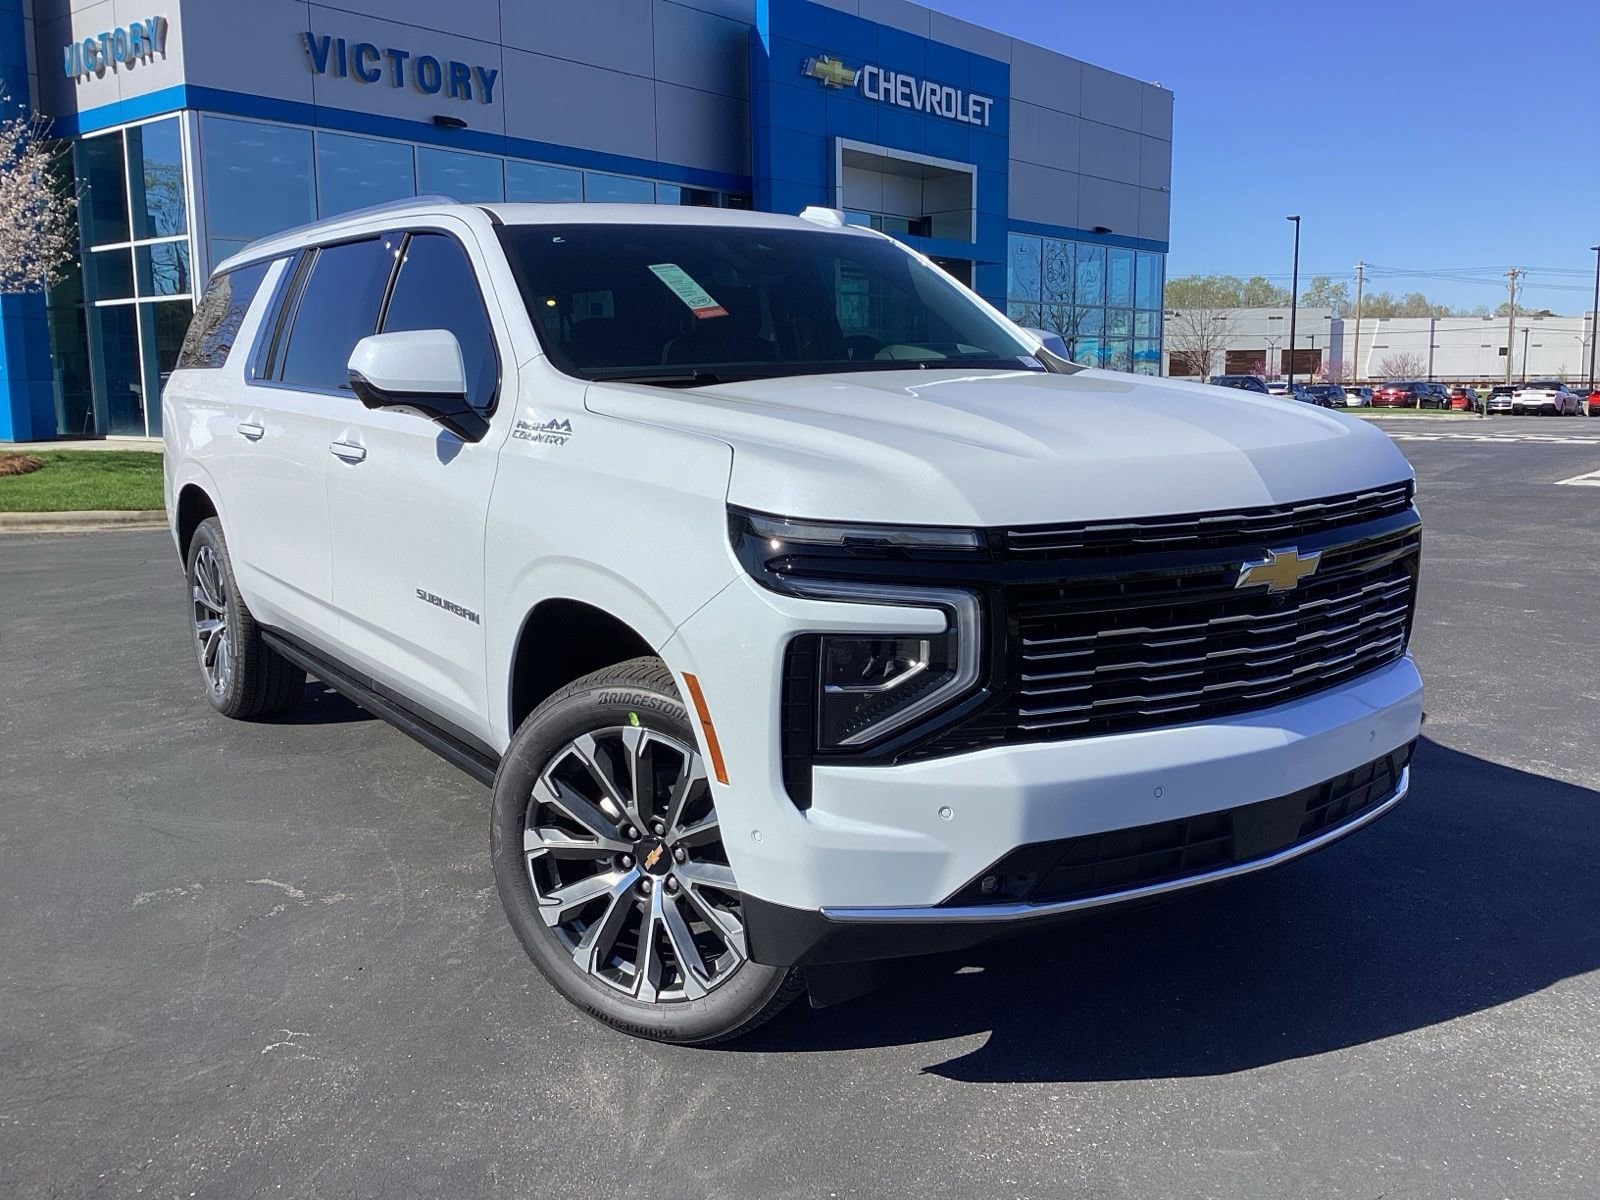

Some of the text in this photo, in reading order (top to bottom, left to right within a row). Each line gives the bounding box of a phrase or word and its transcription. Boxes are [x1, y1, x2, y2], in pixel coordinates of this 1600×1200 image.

[64, 16, 166, 80] VICTORY
[303, 31, 498, 104] VICTORY
[863, 64, 994, 127] CHEVROLET
[416, 588, 480, 625] SUBURBAN
